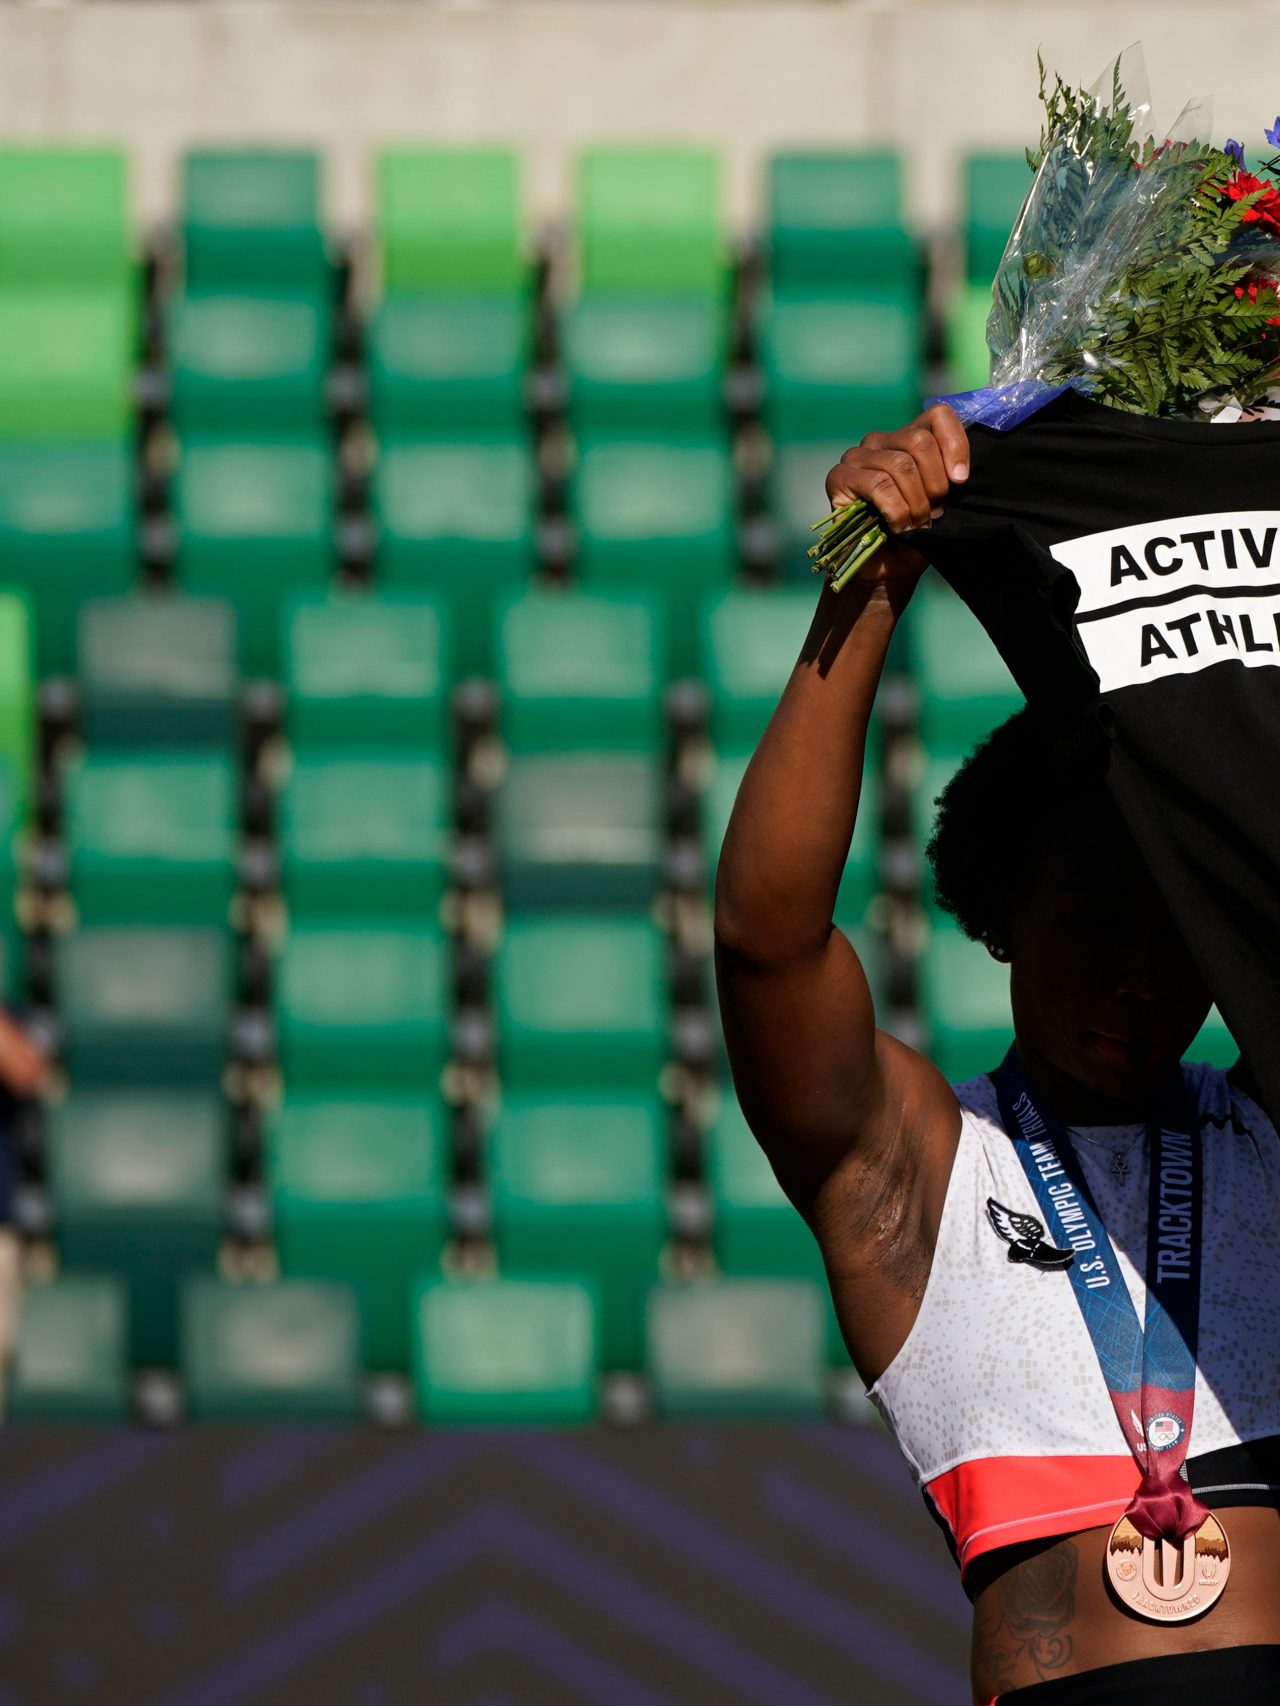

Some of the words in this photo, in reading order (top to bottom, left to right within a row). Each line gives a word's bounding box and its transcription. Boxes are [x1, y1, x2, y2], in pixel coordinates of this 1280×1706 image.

[1012, 1091, 1048, 1142] TRIALS
[1029, 1139, 1065, 1182] TEAM
[1048, 1182, 1096, 1252] OLYMPIC
[1156, 1128, 1193, 1283] TRACKTOWN
[1079, 1255, 1111, 1289] U.S.
